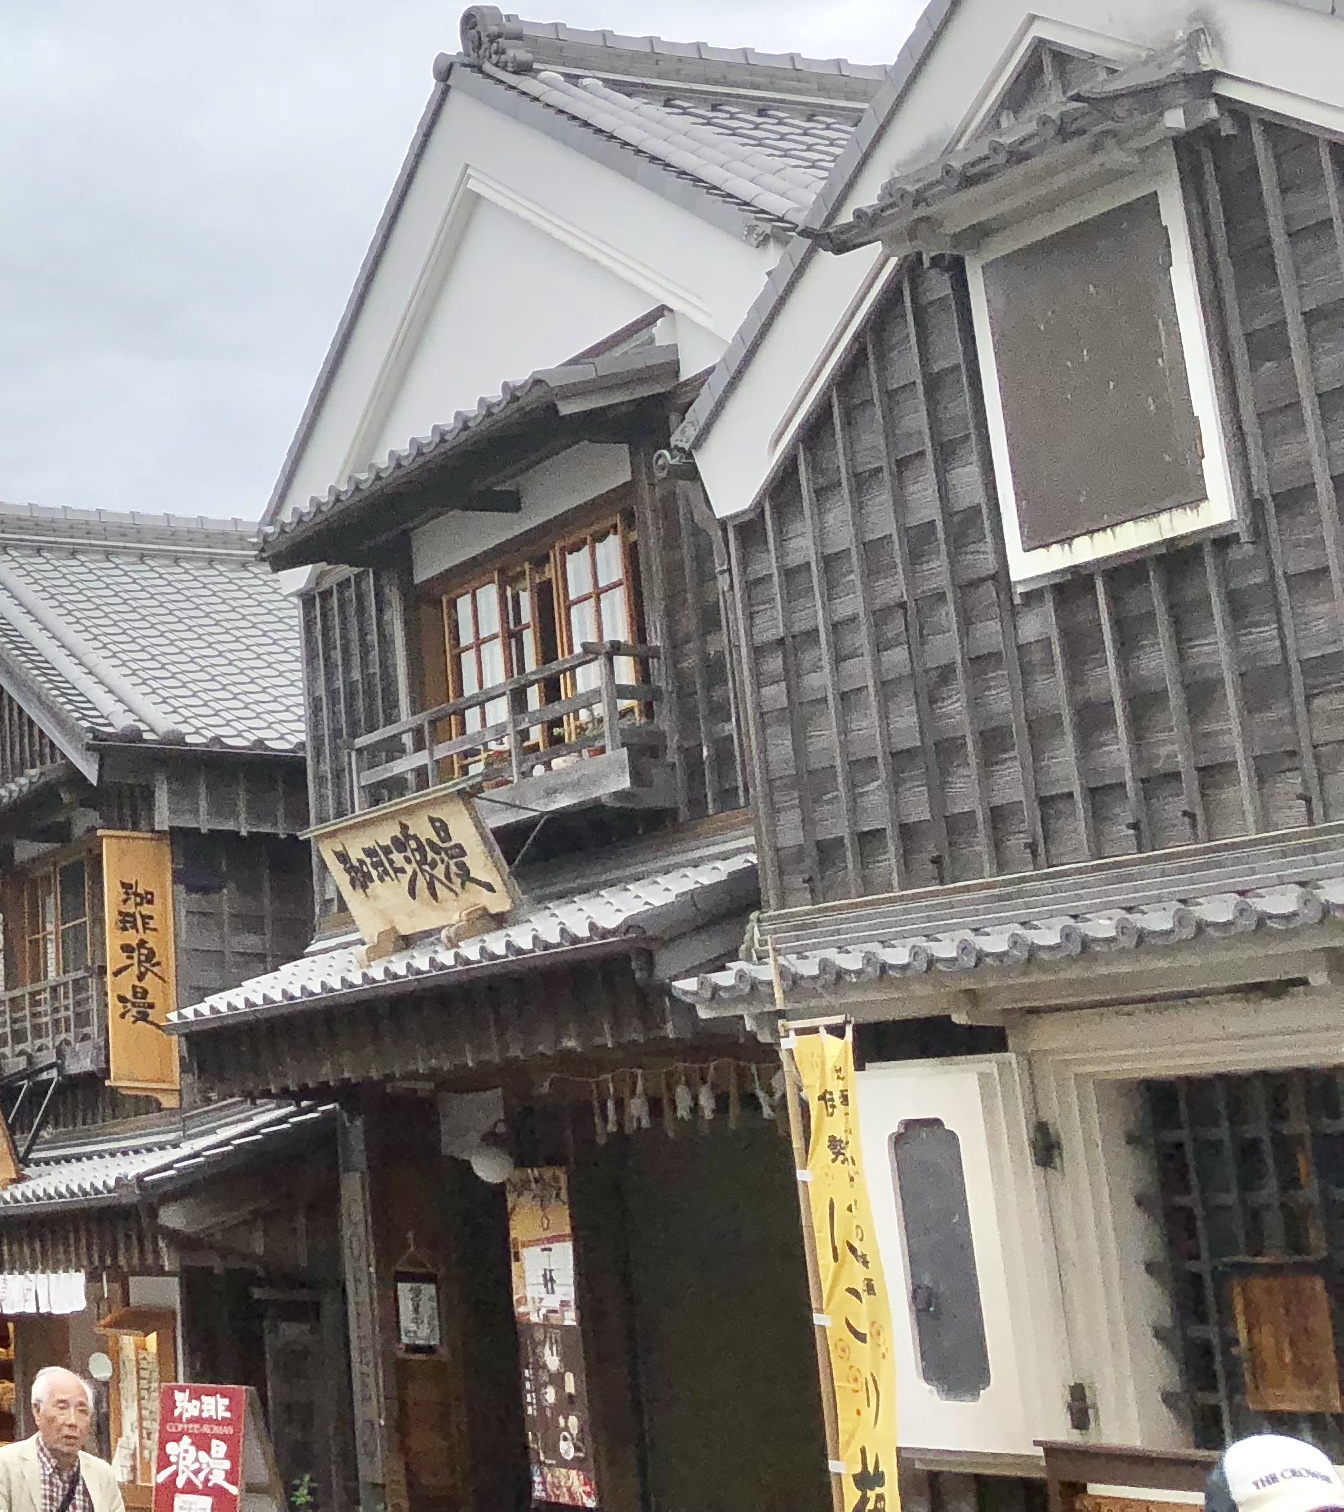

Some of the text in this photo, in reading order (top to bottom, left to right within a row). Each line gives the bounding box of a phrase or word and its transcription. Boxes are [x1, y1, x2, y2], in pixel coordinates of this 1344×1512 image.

[331, 814, 497, 904] 珈琲浪漫
[112, 878, 168, 1035] 珈琲浪漫
[173, 1389, 231, 1422] 珈琲
[156, 1434, 239, 1495] 浪漫
